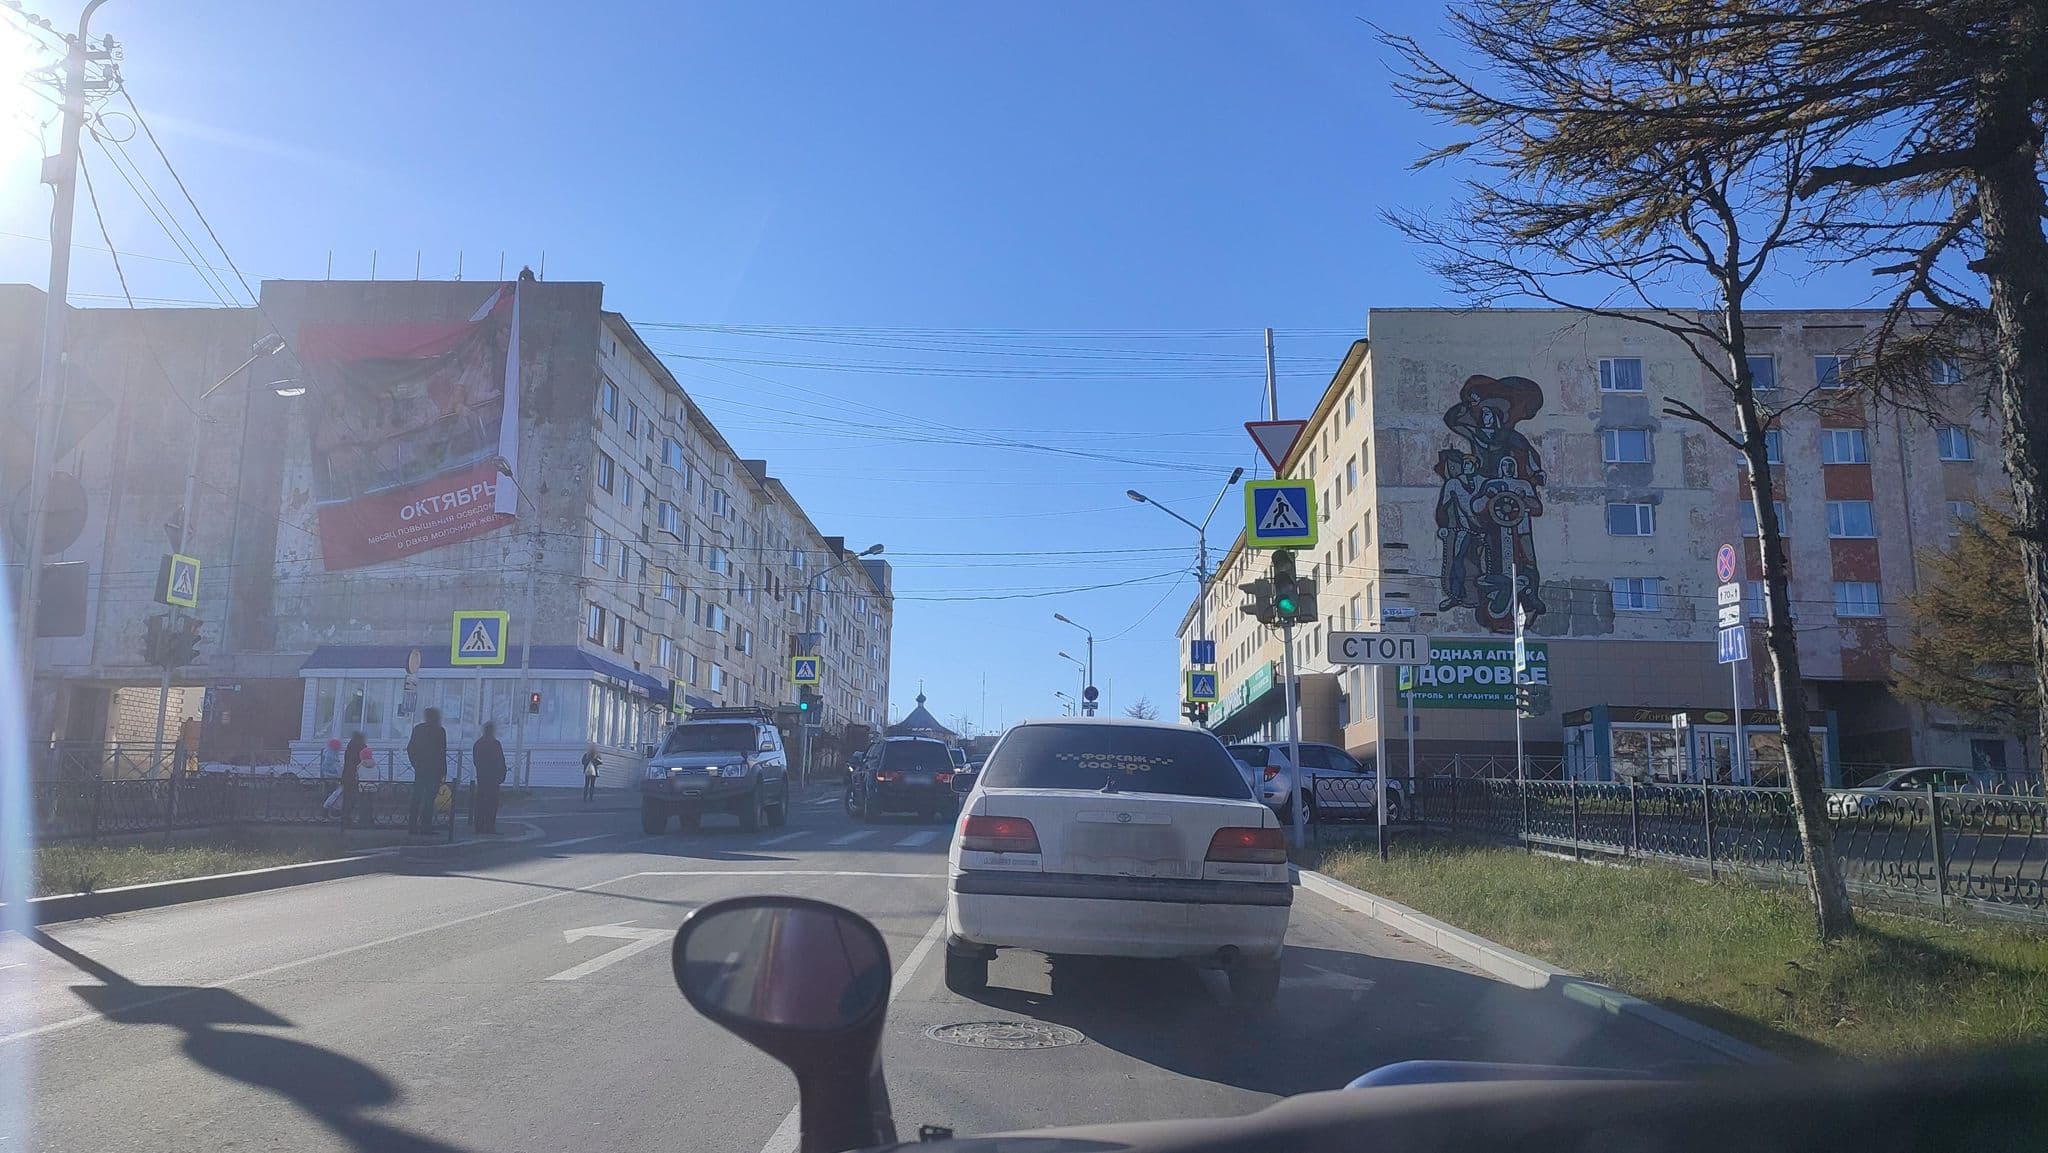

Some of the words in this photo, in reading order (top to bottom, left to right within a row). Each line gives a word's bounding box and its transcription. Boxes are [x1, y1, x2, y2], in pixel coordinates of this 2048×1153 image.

[400, 480, 496, 521] ОКТЯБРЬ
[1342, 637, 1416, 659] СТОП
[1430, 649, 1482, 661] ОДНАЯ
[1486, 649, 1546, 661] АПТКА
[1419, 665, 1548, 686] ДОРОВЬЕ
[1078, 761, 1151, 772] 600-500
